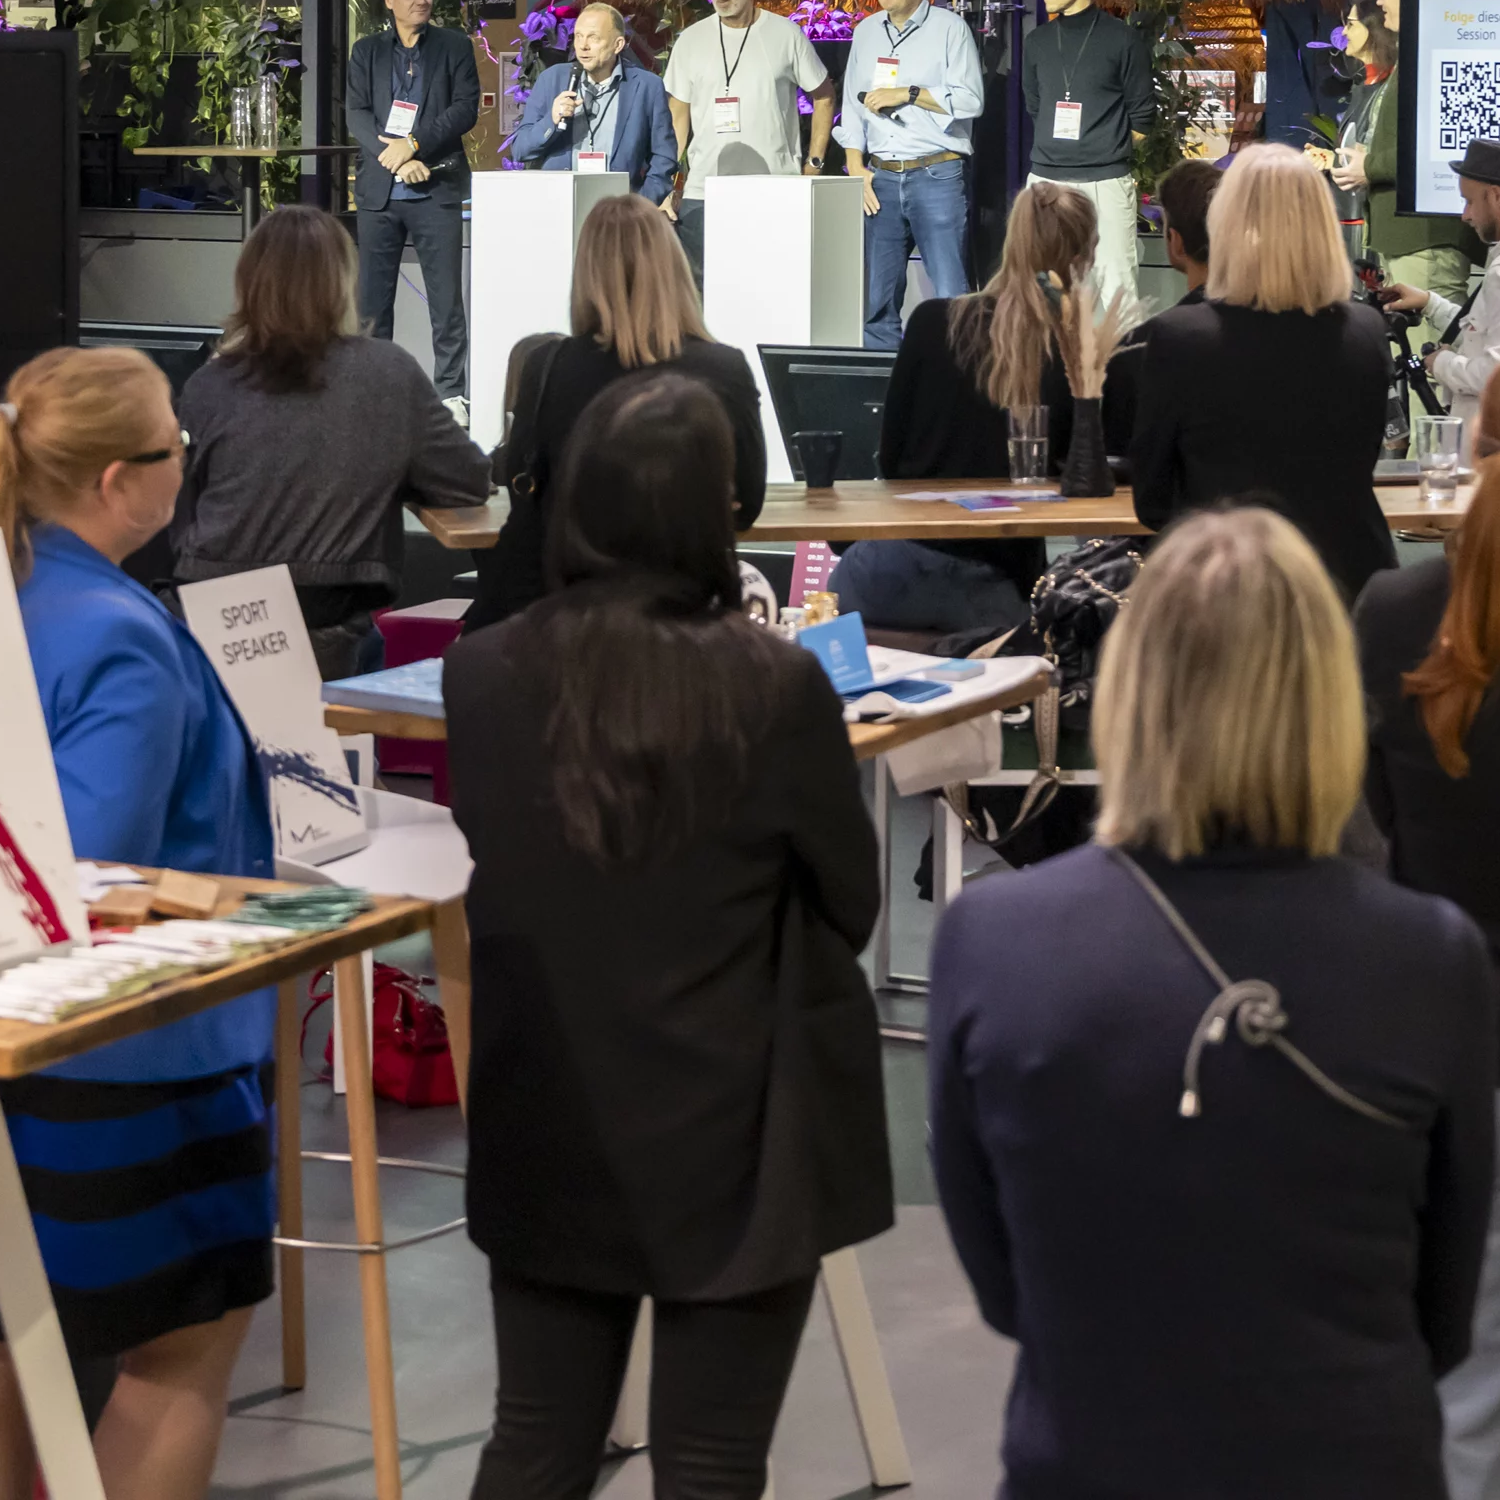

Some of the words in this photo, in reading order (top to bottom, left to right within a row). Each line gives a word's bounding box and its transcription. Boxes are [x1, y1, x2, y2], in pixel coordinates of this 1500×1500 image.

[1444, 11, 1475, 25] Folge
[1456, 28, 1497, 41] Session
[221, 598, 272, 630] SPORT
[221, 630, 291, 666] SPEAKER
